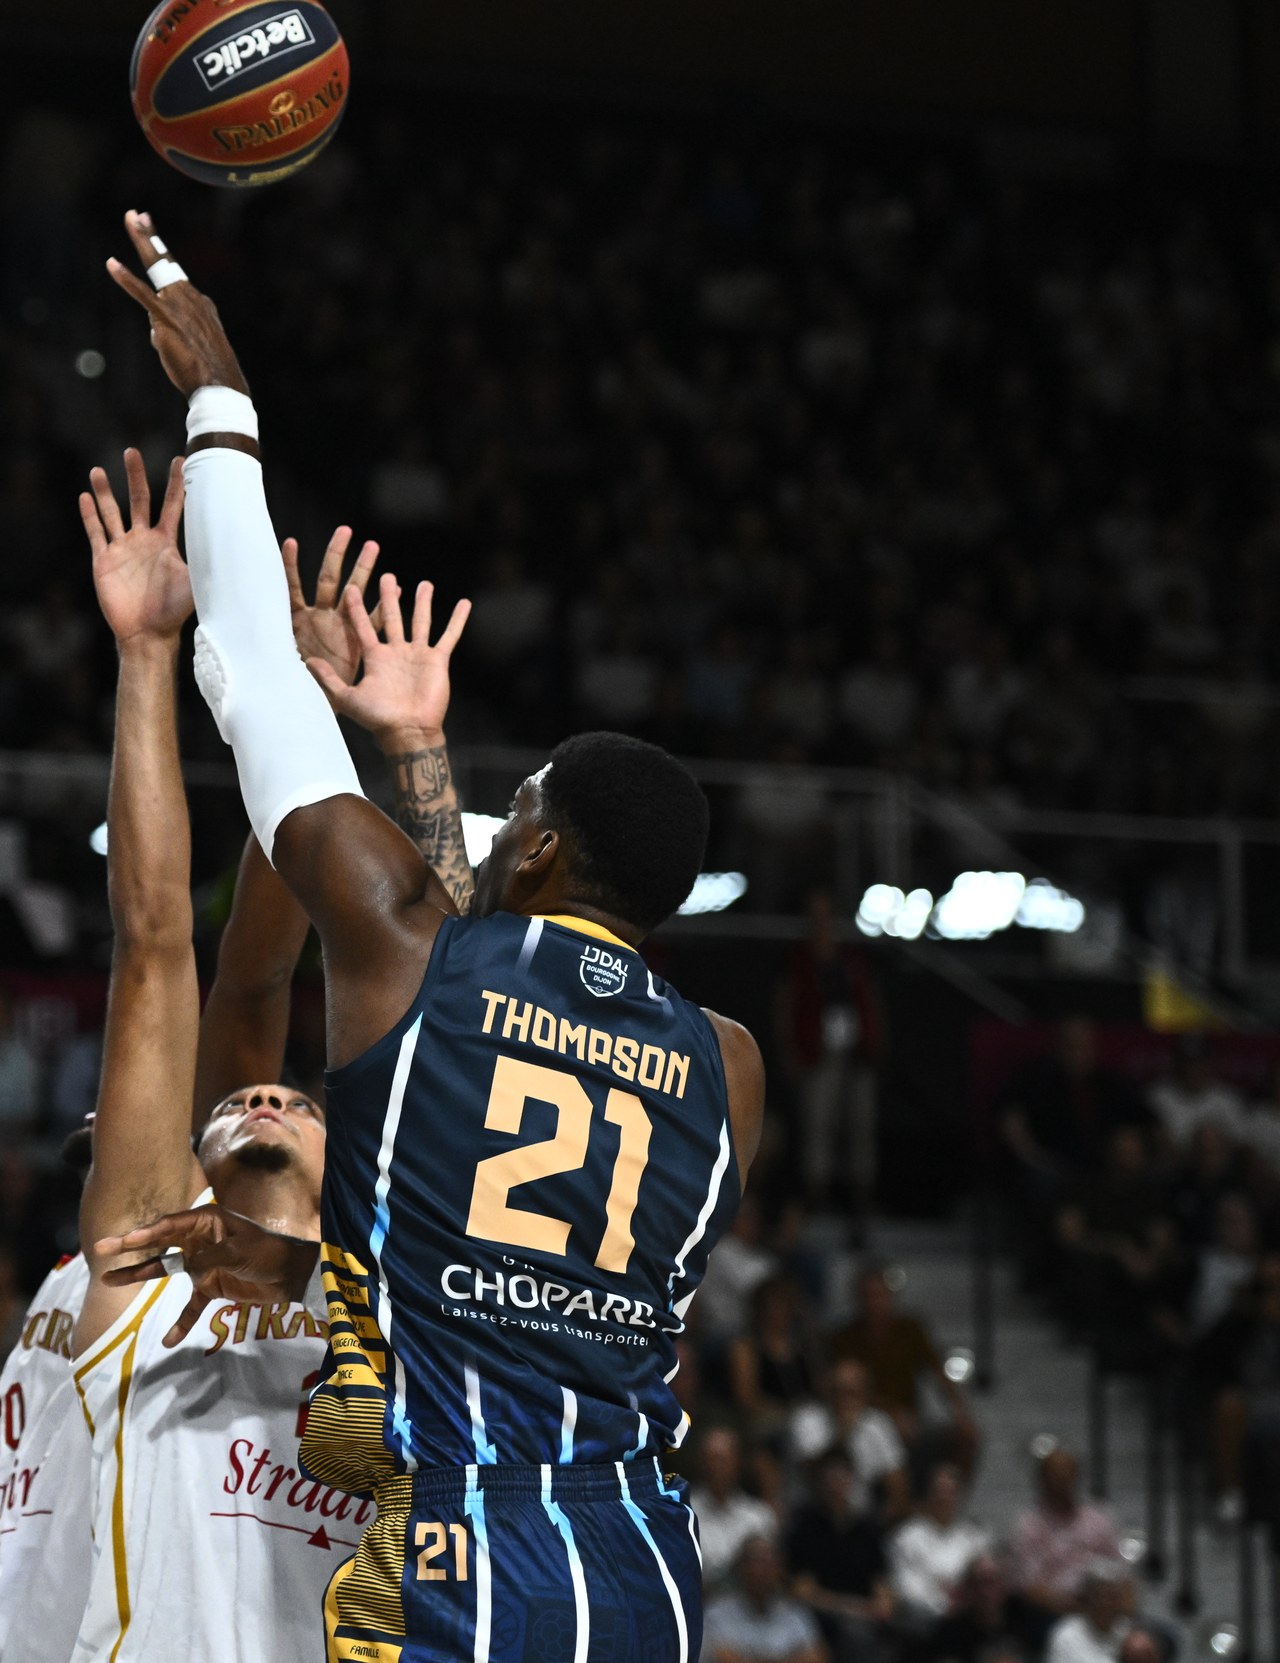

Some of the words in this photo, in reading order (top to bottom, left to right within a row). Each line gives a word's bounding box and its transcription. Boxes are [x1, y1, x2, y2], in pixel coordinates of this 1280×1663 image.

[203, 14, 307, 77] Betclic
[211, 71, 343, 152] SPALDING
[586, 964, 620, 983] BOURGOGNE
[593, 974, 612, 986] DIJON
[481, 989, 691, 1099] THOMPSON
[465, 1055, 653, 1274] 21
[441, 1304, 559, 1333] Laissez-vous
[414, 1522, 468, 1582] 21
[349, 1645, 380, 1658] FAMILLE
